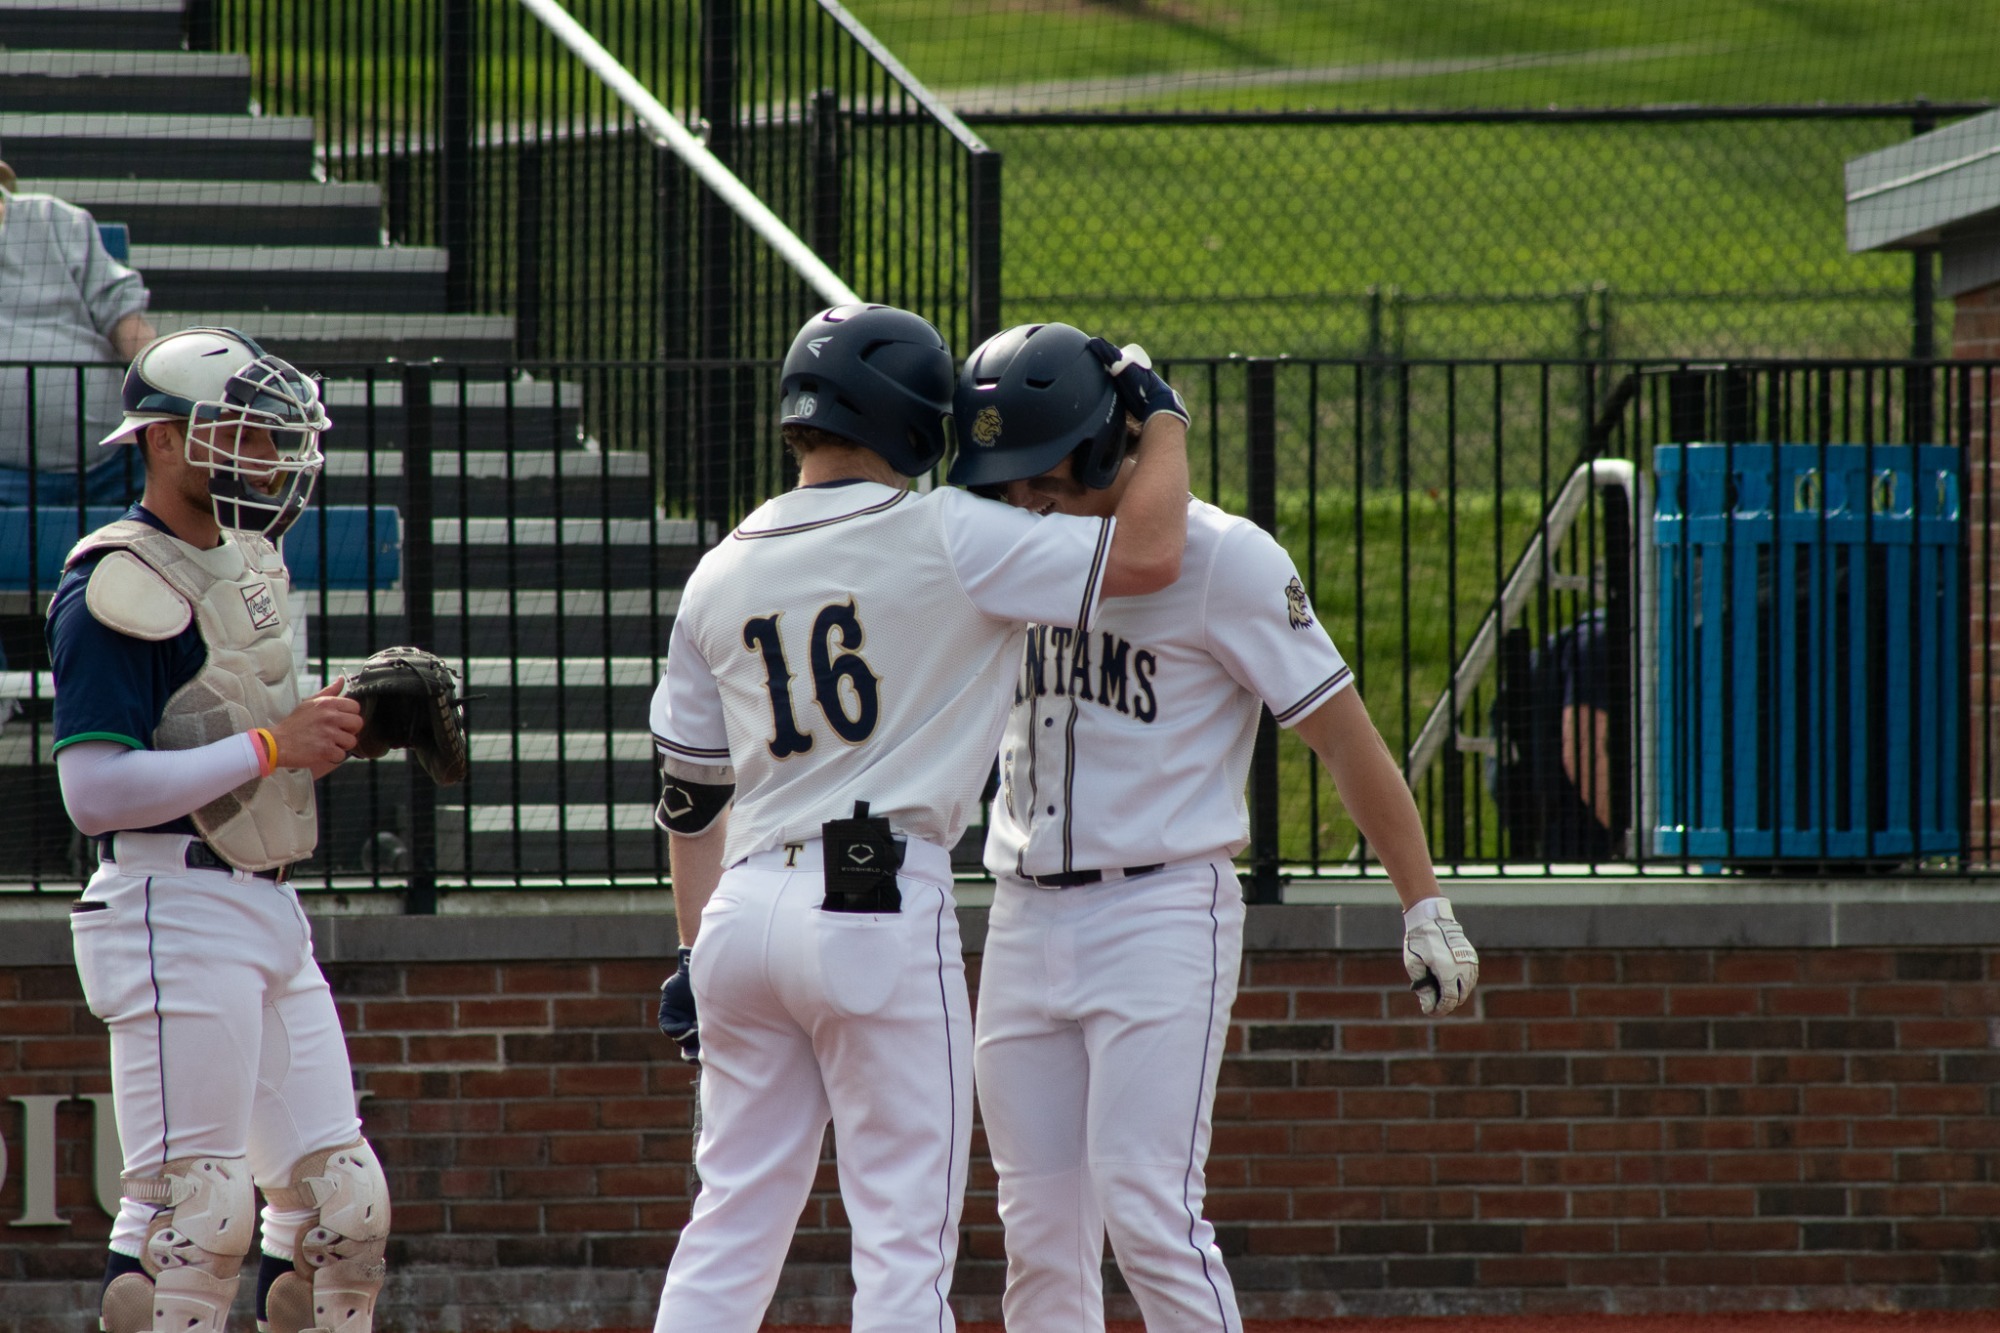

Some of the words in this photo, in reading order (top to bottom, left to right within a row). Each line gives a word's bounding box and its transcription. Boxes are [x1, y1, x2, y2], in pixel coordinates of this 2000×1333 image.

[799, 395, 815, 416] 16
[742, 593, 882, 761] 16
[1014, 624, 1157, 724] NTAMS
[784, 843, 804, 869] T
